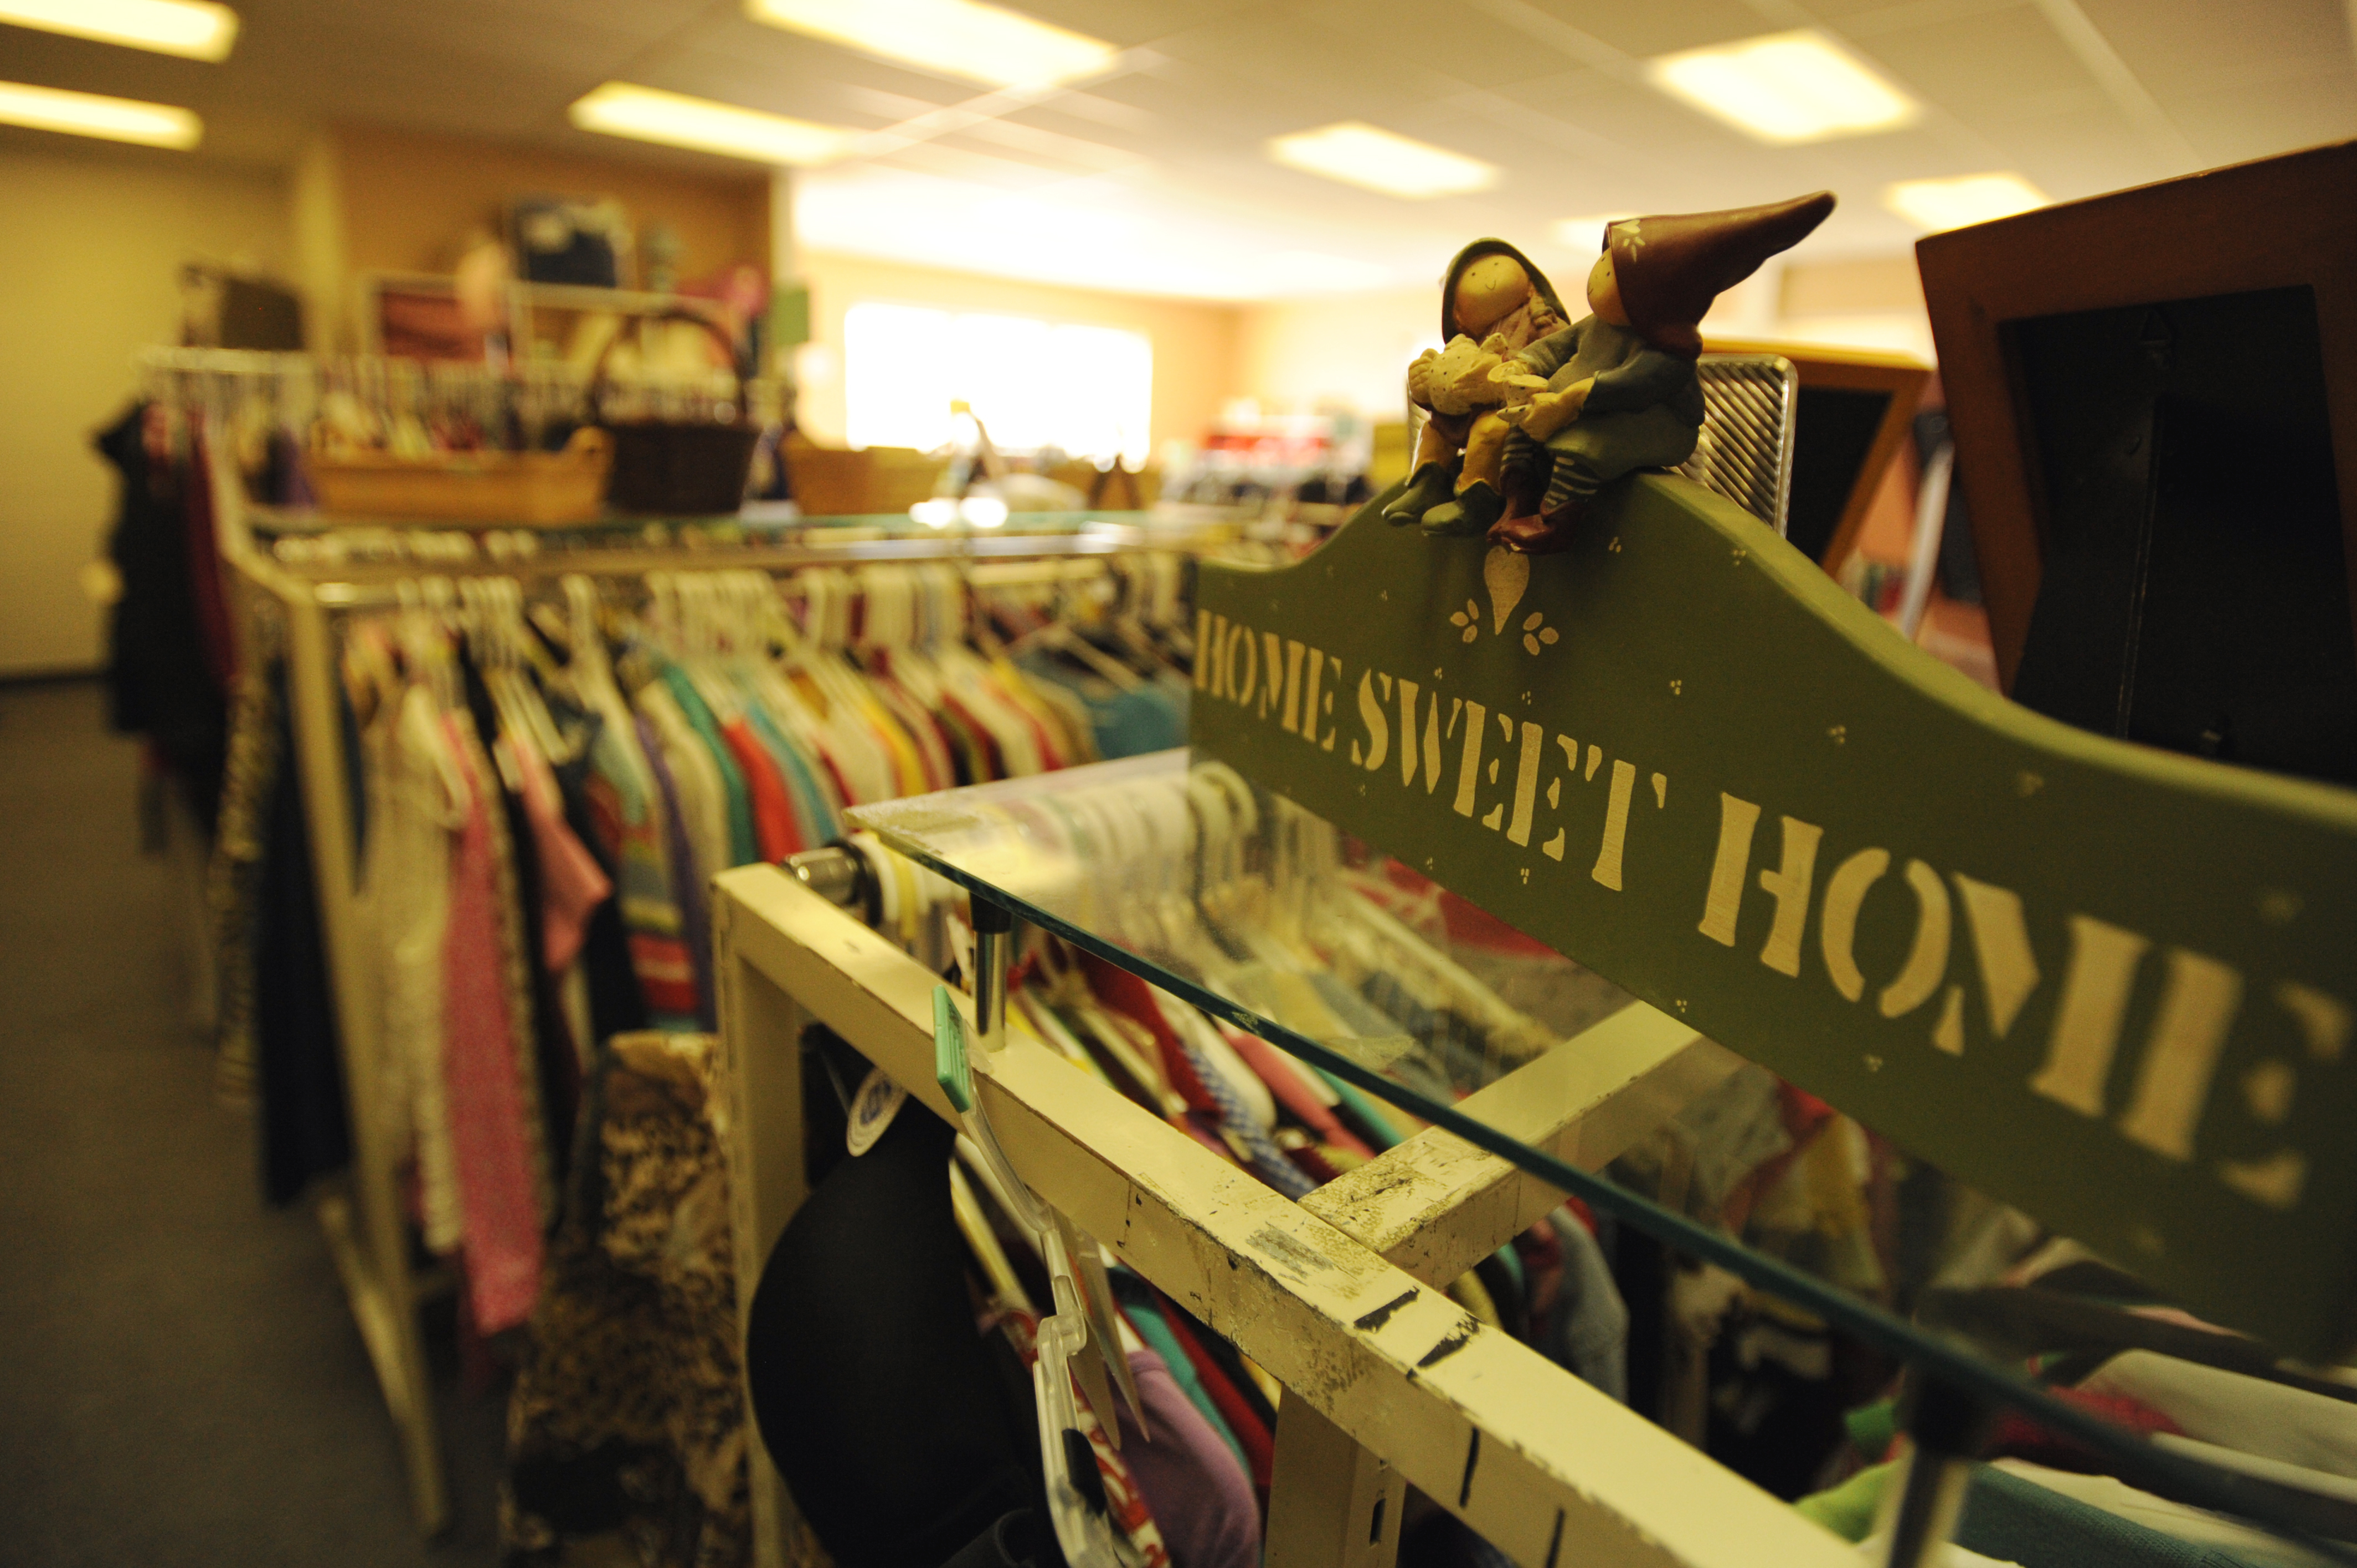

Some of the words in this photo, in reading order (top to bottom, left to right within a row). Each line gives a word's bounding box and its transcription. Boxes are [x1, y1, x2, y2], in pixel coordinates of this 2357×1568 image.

[1193, 609, 1341, 751] HOME
[1350, 668, 1667, 891] SWEET
[1698, 792, 2351, 1208] HOME
